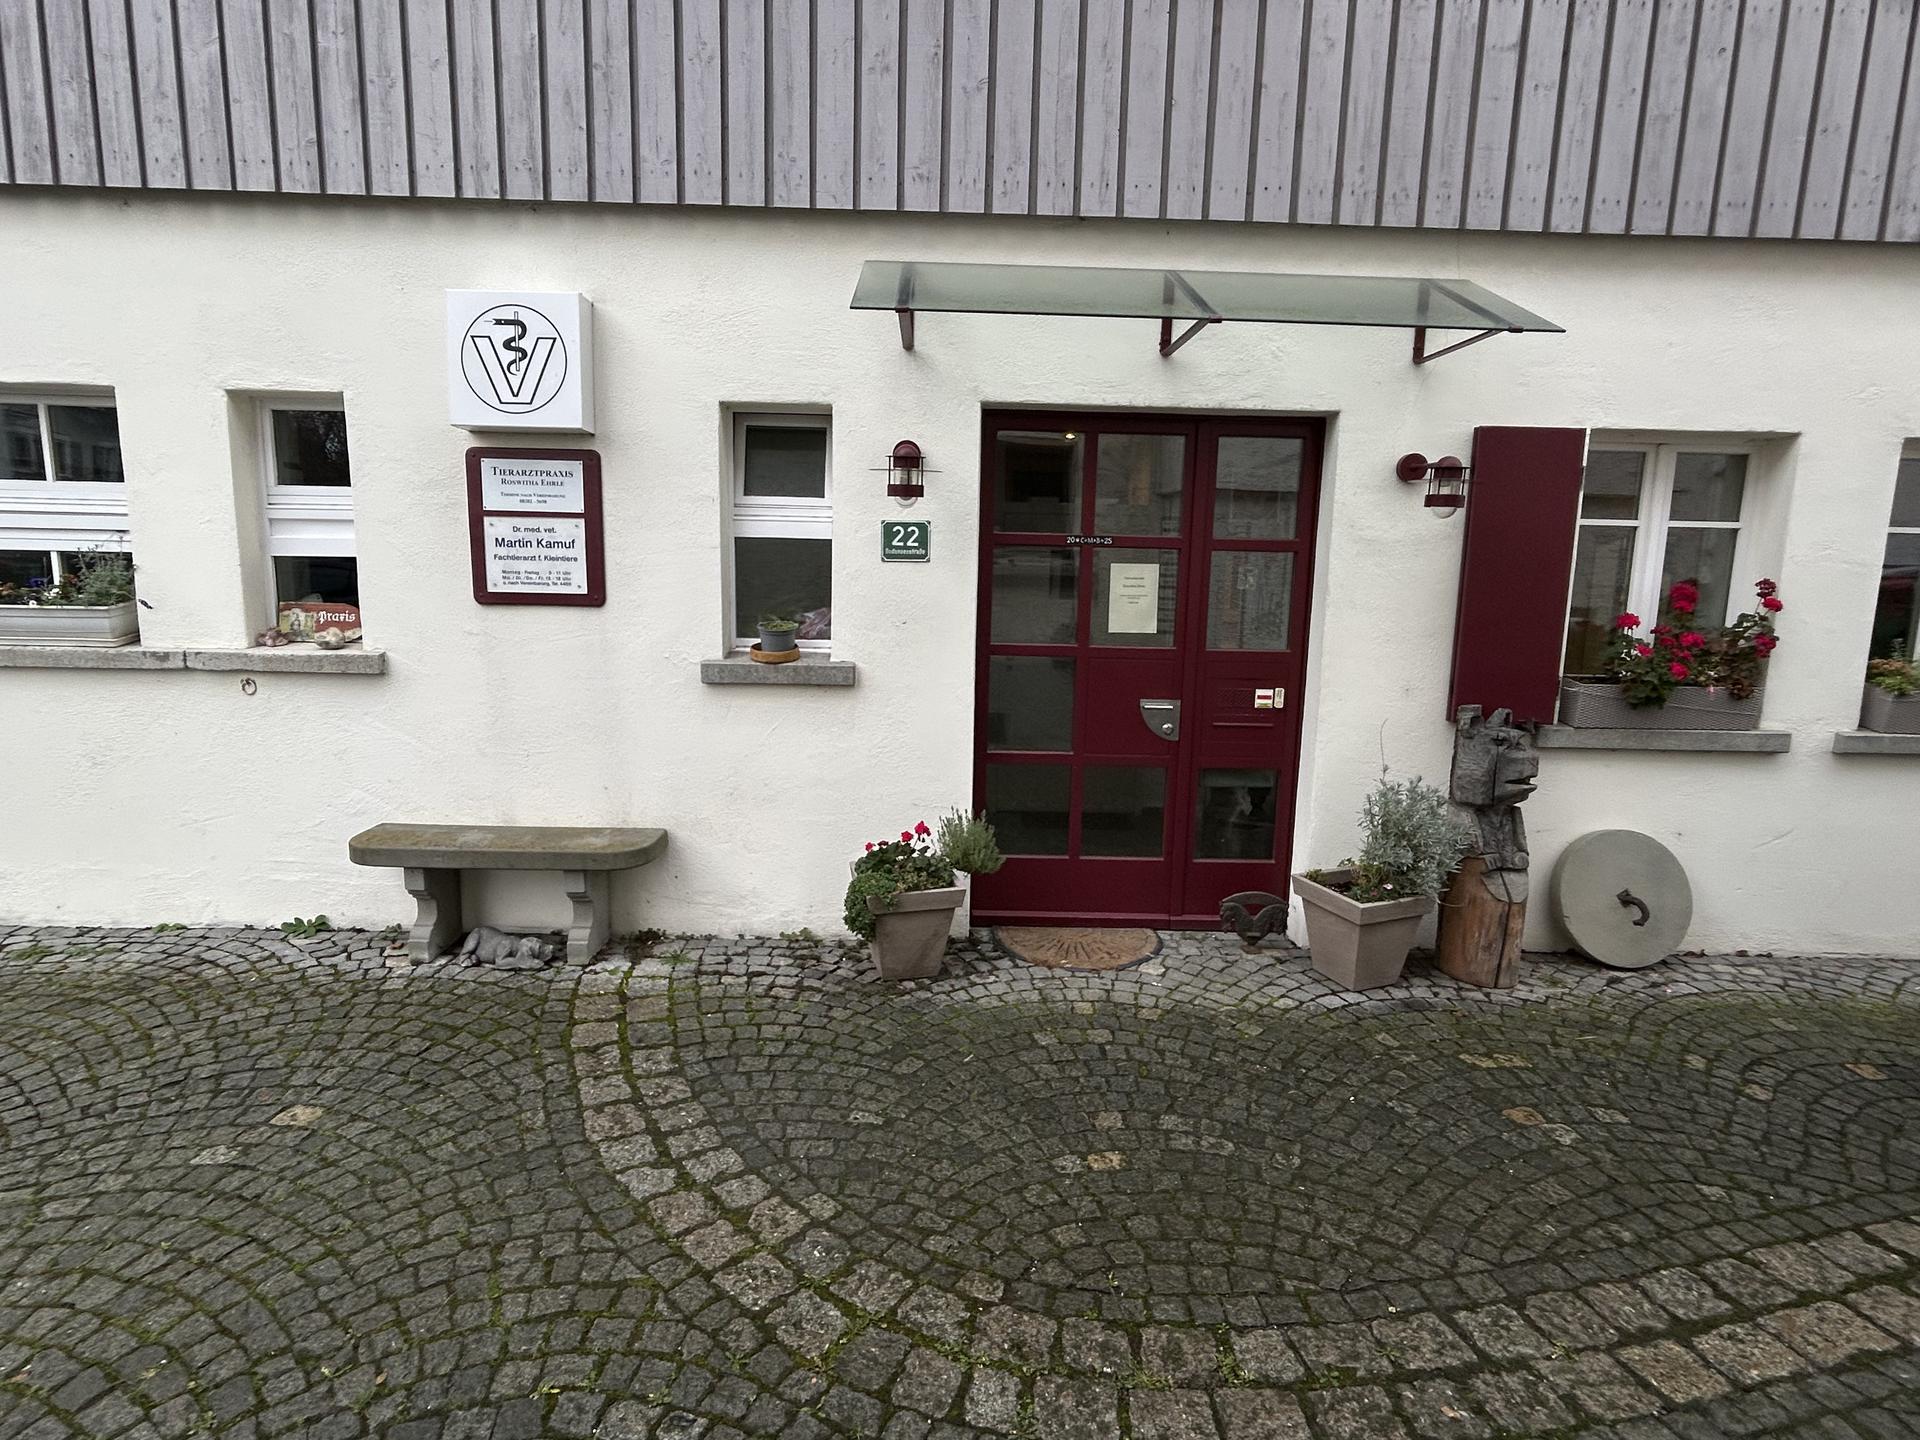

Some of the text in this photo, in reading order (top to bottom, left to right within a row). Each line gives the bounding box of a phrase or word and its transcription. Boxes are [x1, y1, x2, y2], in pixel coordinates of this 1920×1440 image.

[892, 526, 919, 546] 22
[494, 537, 576, 549] Martin Kamuf
[493, 553, 537, 562] Fachtierarzt
[544, 555, 578, 563] Kleintiere
